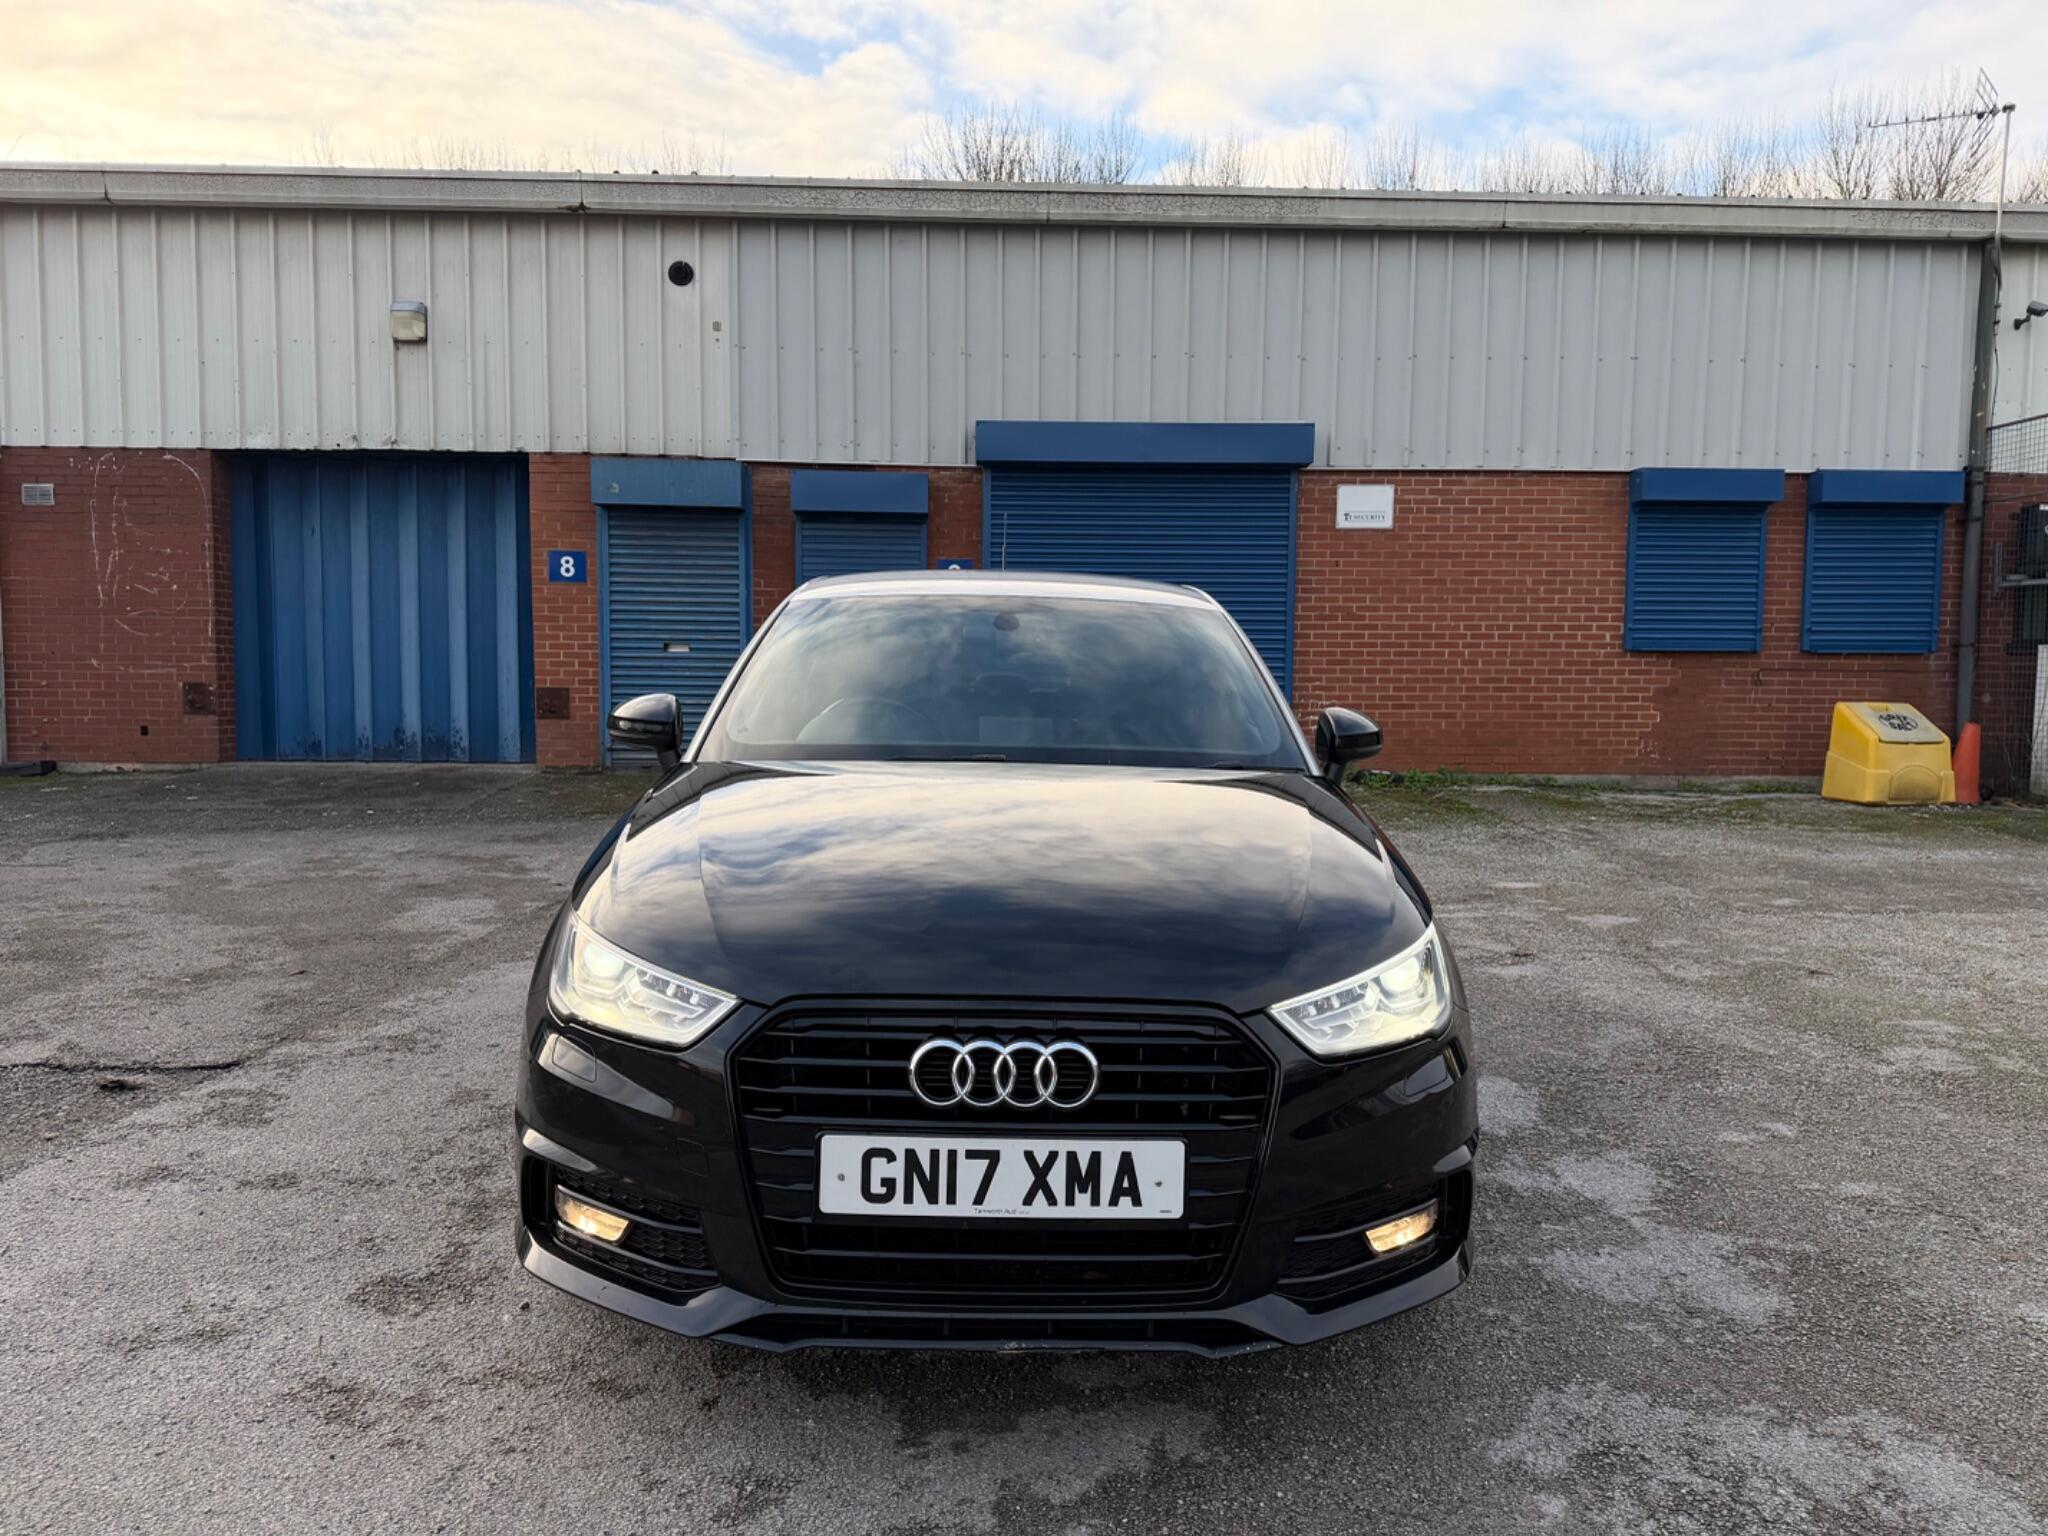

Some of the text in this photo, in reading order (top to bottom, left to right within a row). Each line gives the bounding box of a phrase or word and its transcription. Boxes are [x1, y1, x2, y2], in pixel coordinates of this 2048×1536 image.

[560, 555, 576, 578] 8
[861, 1147, 1144, 1207] GN17 XMA
